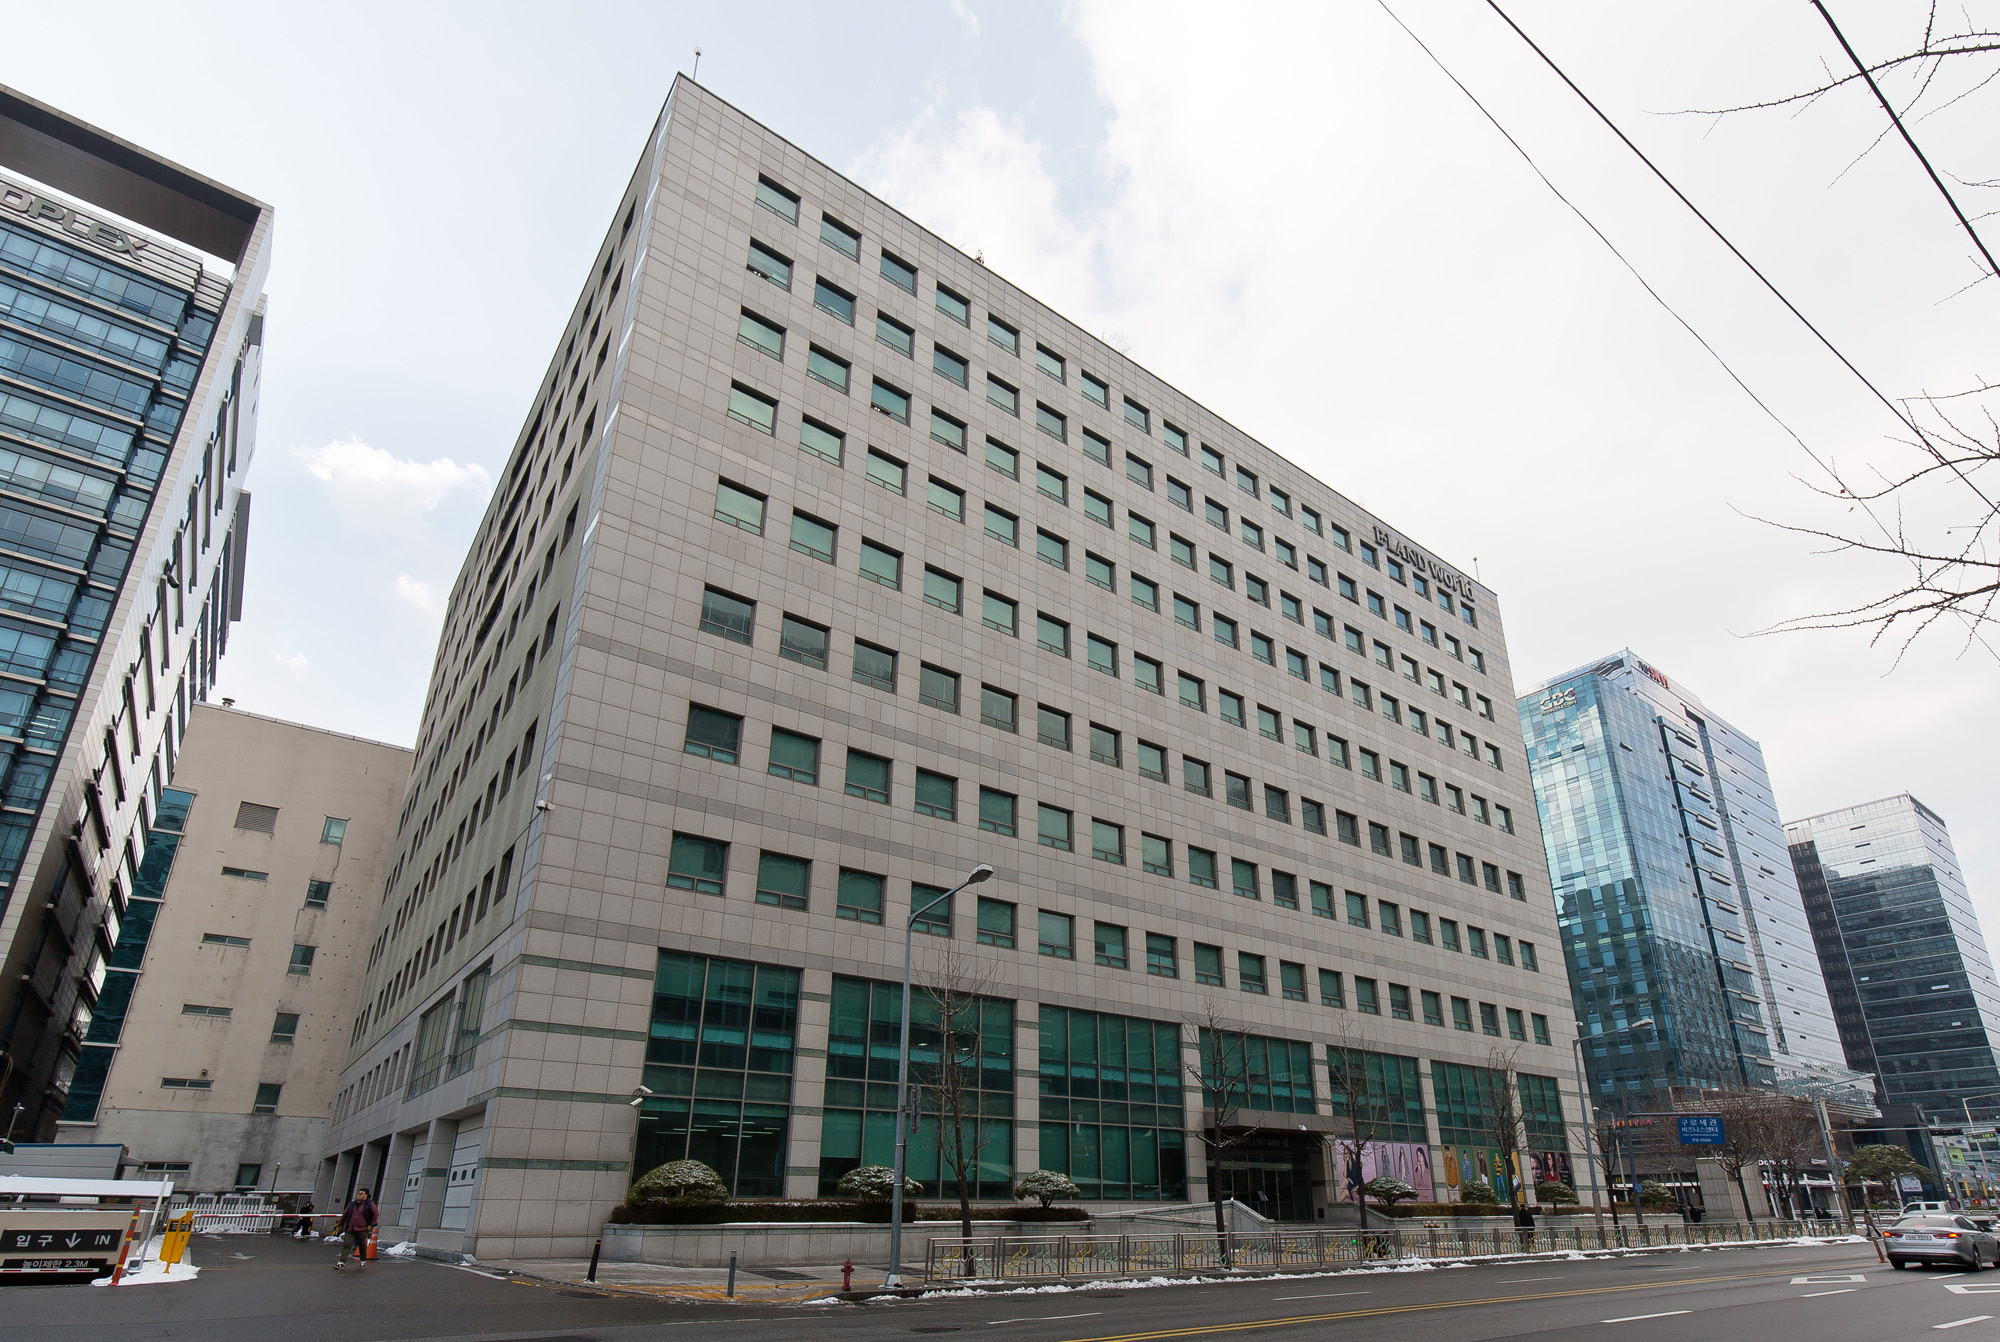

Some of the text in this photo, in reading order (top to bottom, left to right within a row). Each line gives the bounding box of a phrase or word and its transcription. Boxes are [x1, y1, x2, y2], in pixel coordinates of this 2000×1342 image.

[1681, 1118, 1717, 1126] 구로세관
[16, 1234, 111, 1247] 입구 IN
[22, 1260, 88, 1269] 높이제한 2.3M
